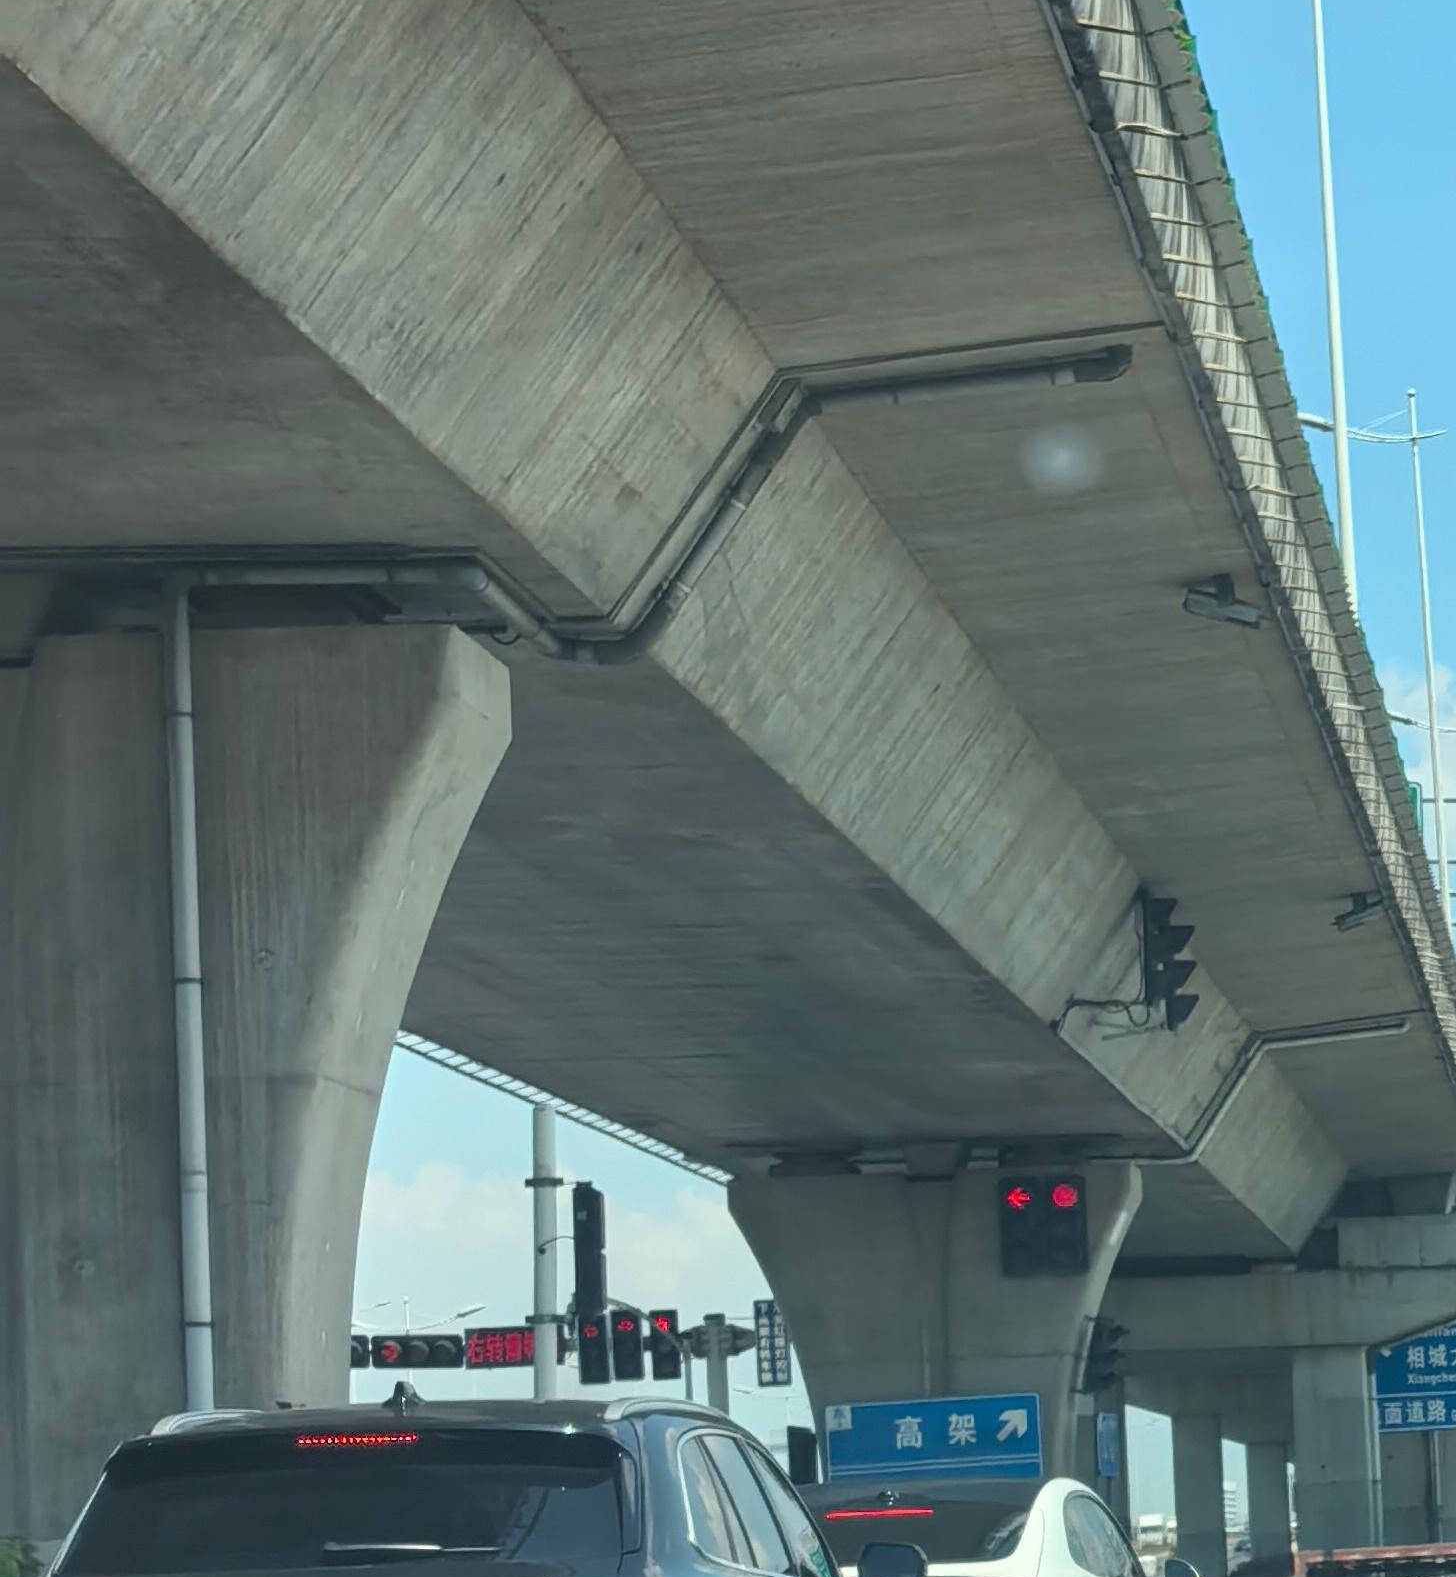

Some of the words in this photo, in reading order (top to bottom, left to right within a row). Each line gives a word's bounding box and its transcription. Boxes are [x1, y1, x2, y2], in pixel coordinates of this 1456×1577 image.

[1378, 1399, 1447, 1425] 面道路
[894, 1413, 977, 1450] 高架
